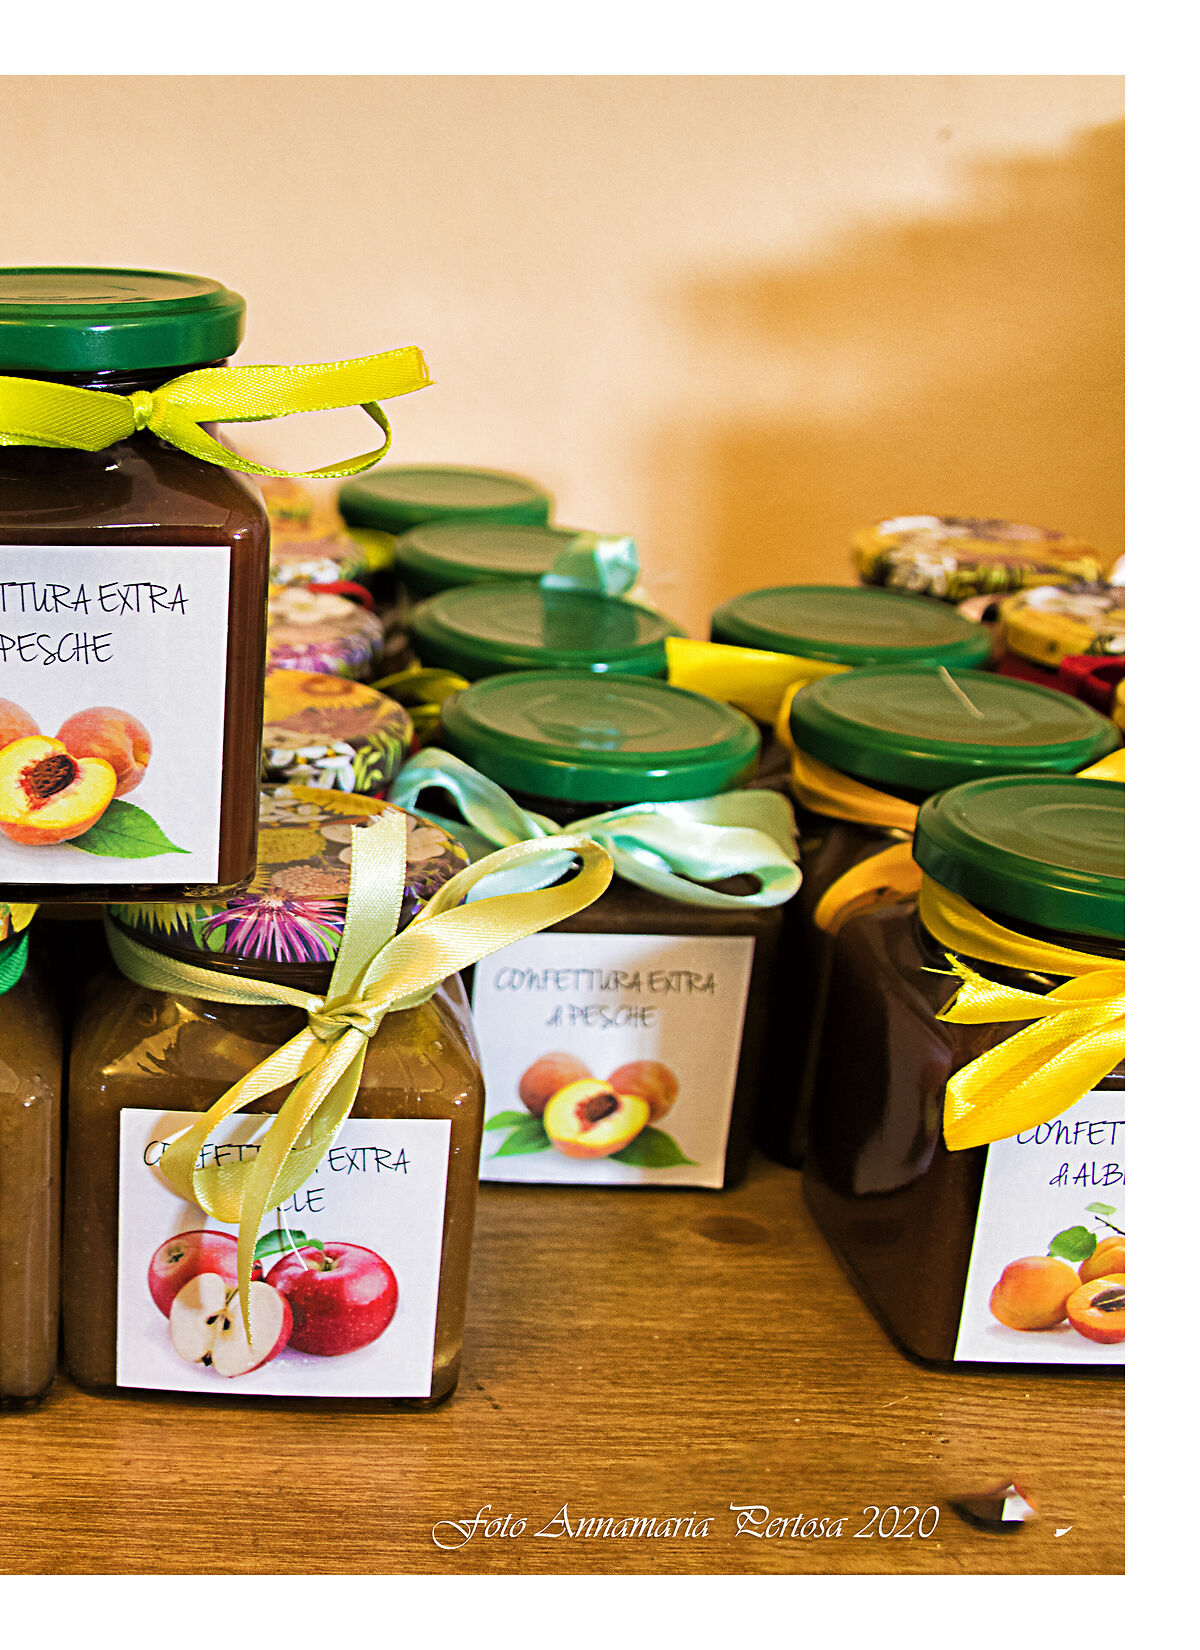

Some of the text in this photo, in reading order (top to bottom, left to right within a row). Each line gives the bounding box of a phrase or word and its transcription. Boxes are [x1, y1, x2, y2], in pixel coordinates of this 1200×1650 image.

[97, 581, 189, 616] EXTRA
[650, 969, 719, 995] EXTRA
[568, 1003, 657, 1029] PESCHE
[328, 1146, 412, 1175] EXTRA
[1048, 1161, 1125, 1188] di ALB
